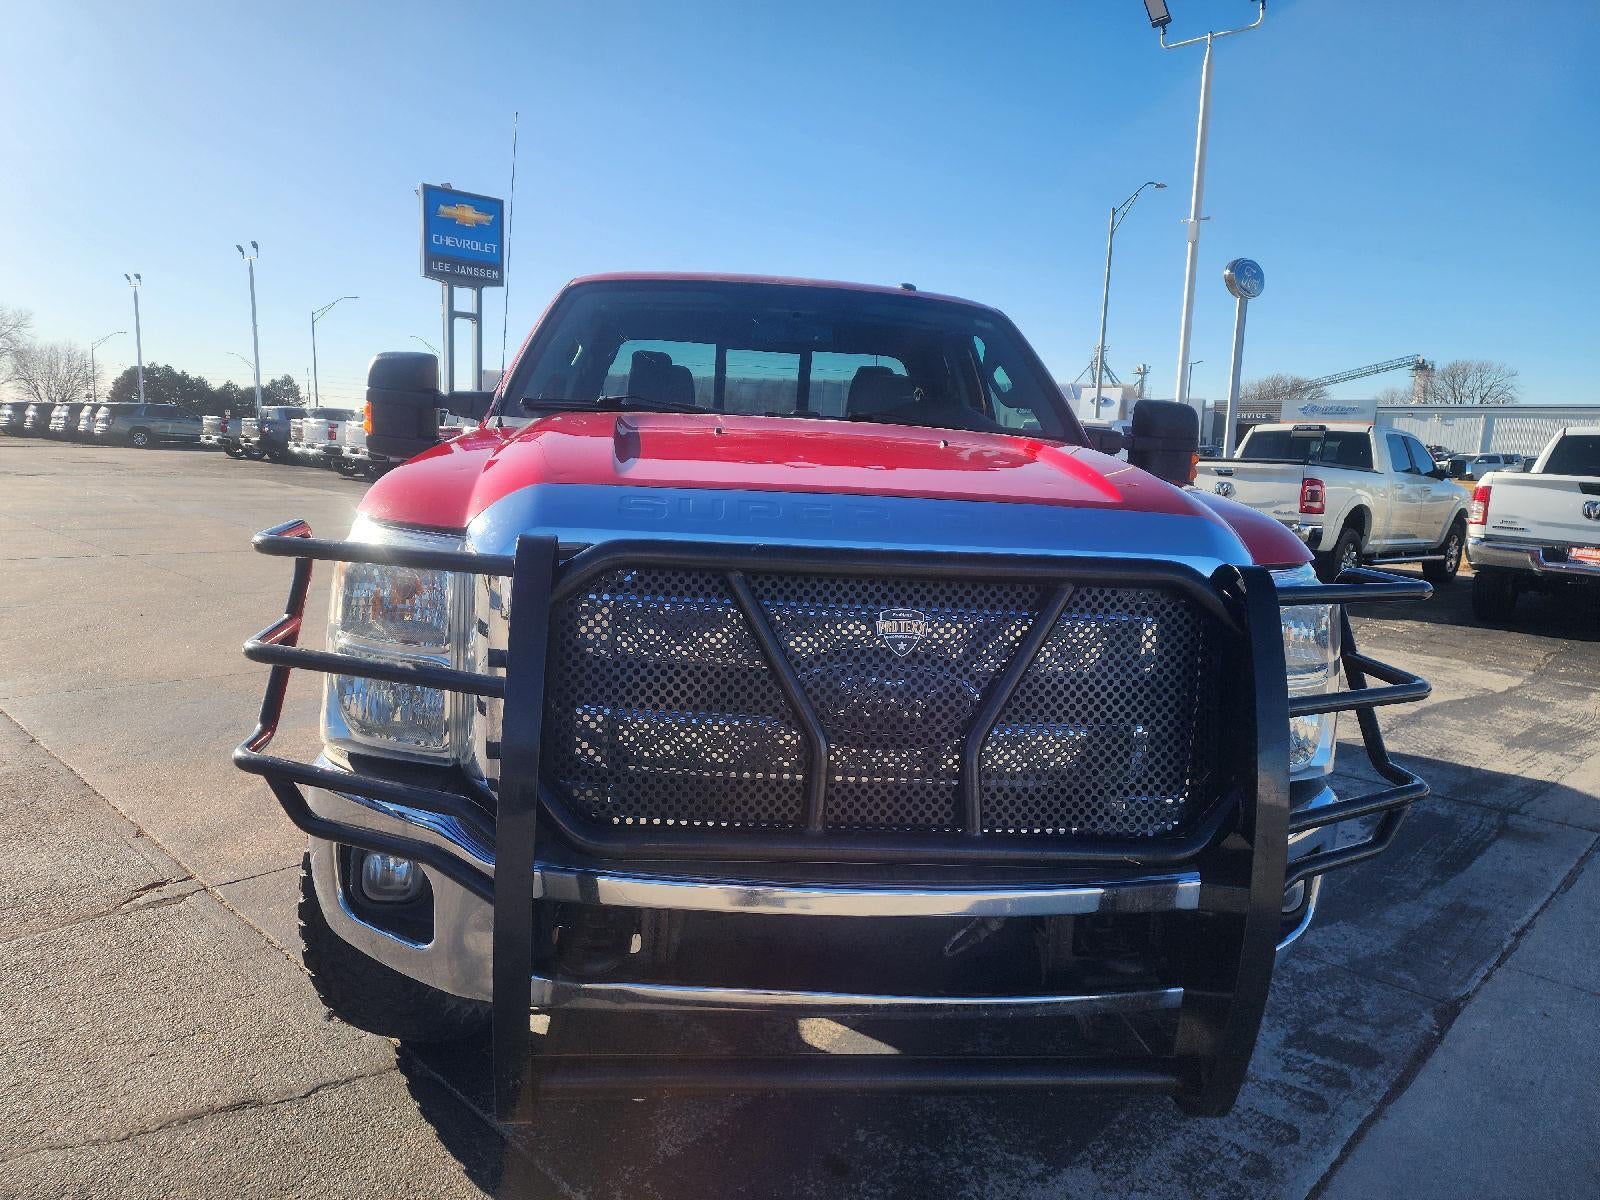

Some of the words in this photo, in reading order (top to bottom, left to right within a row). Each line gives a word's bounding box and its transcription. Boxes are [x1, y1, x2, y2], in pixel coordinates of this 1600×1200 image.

[432, 233, 498, 254] CHEVROLET
[432, 261, 451, 272] LEE
[454, 265, 499, 279] JANSSEN
[618, 494, 891, 528] SUPER
